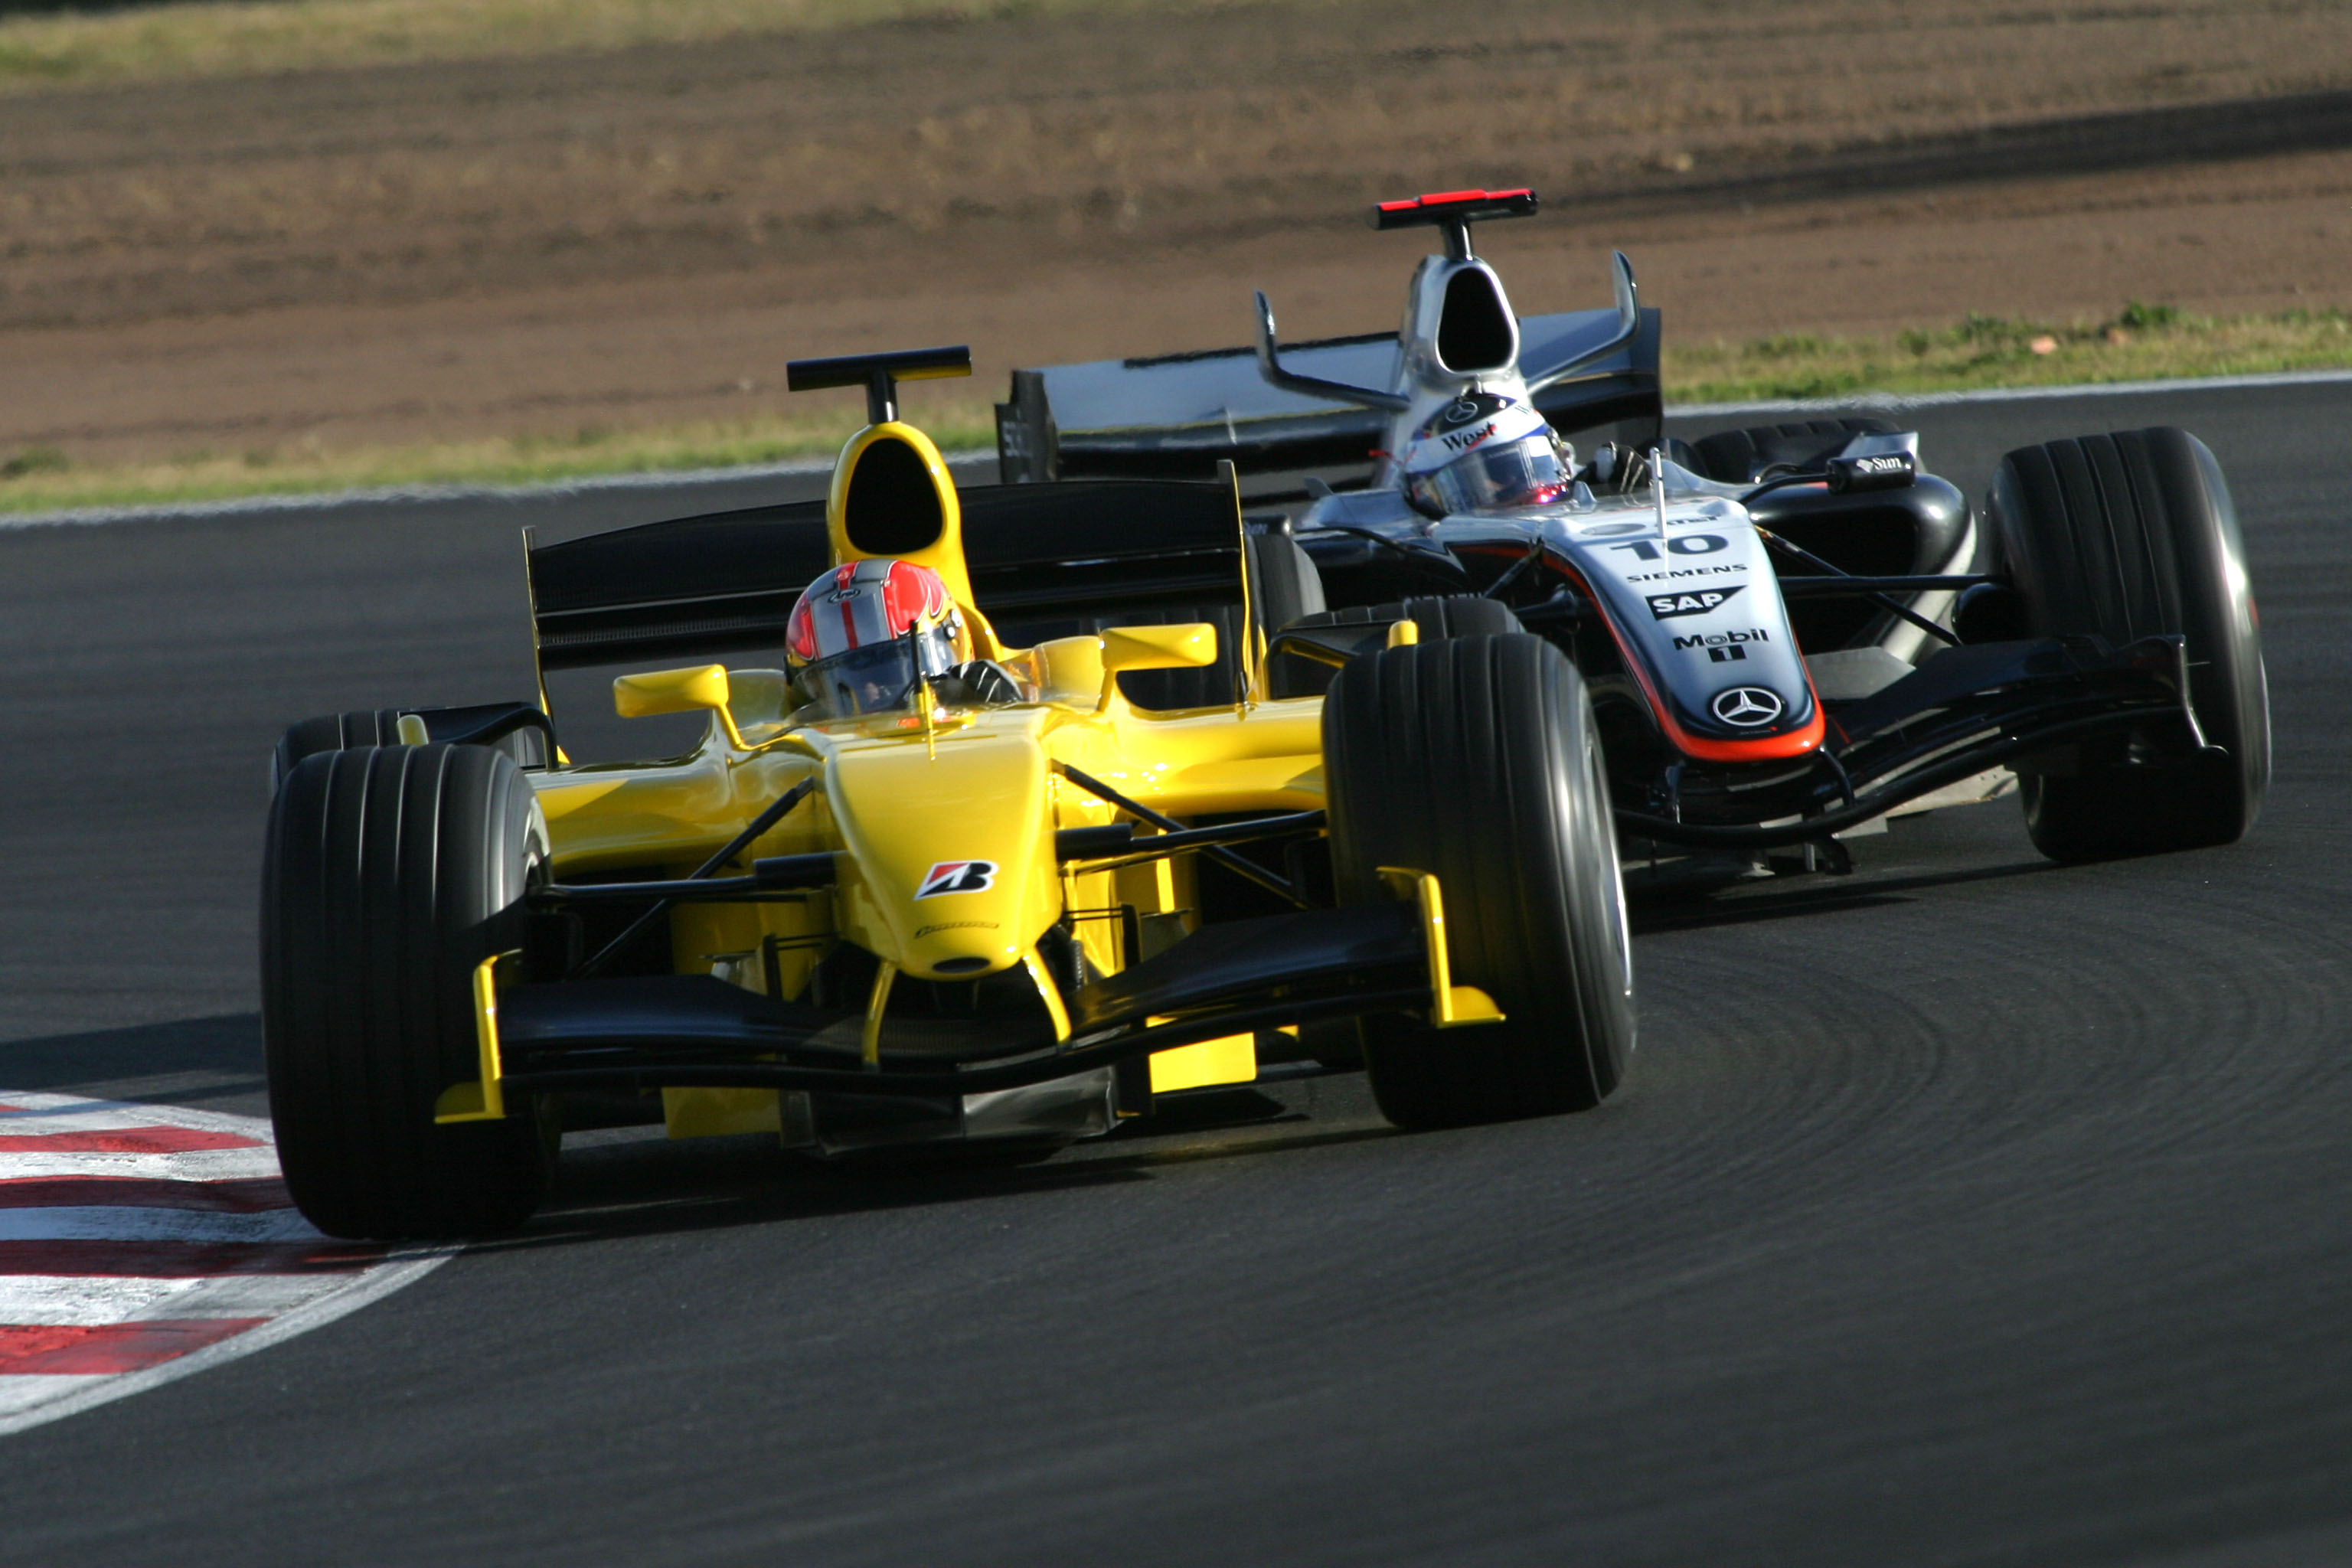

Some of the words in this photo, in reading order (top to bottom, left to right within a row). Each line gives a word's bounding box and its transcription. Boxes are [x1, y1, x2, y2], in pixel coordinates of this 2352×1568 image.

[1442, 421, 1494, 450] West
[1872, 458, 1901, 470] Sun
[1609, 534, 1729, 560] 10
[1627, 564, 1748, 583] SIEMENS
[1653, 593, 1724, 612] SAP
[1673, 629, 1769, 650] Mobil
